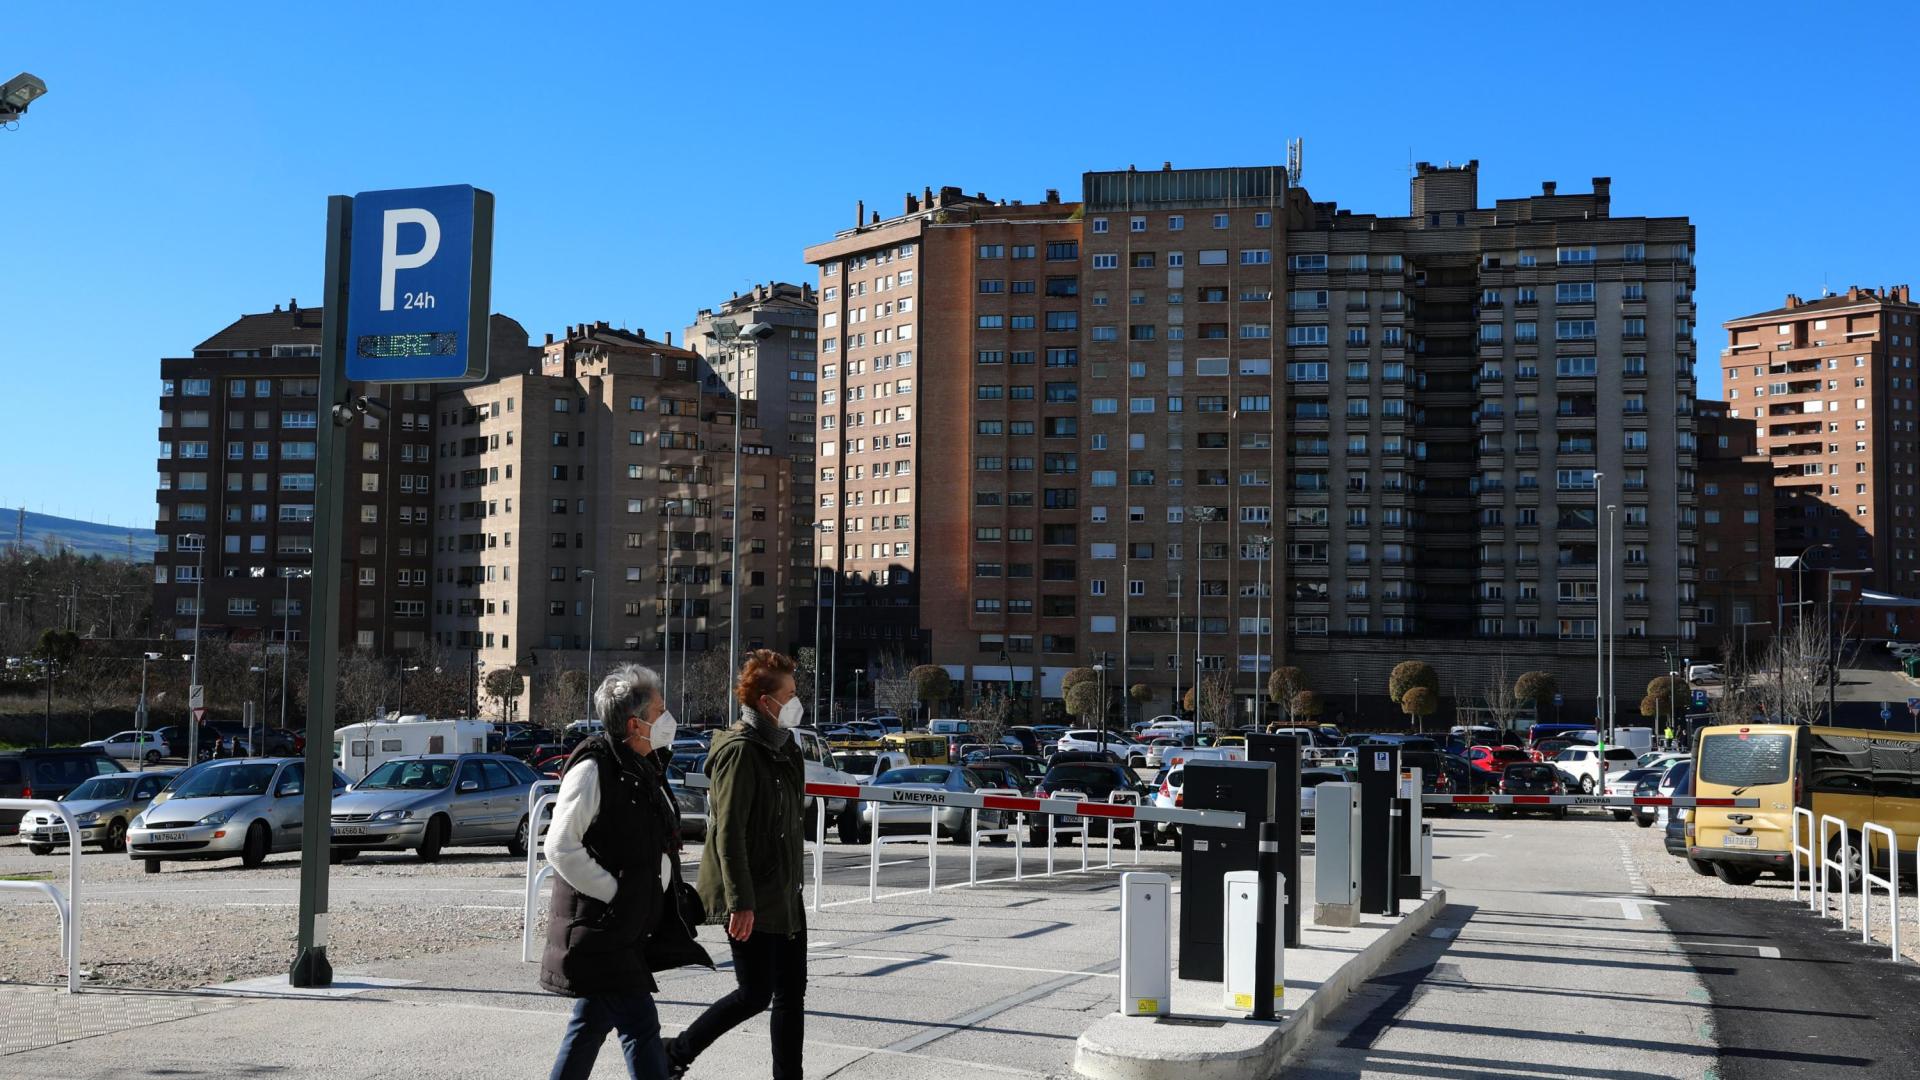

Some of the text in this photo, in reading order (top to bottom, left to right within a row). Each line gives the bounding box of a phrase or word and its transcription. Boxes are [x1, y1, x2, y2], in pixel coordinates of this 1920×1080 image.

[379, 207, 441, 311] P
[403, 291, 435, 310] 24h
[376, 334, 432, 357] LIBRE
[904, 792, 945, 803] MEYPAR
